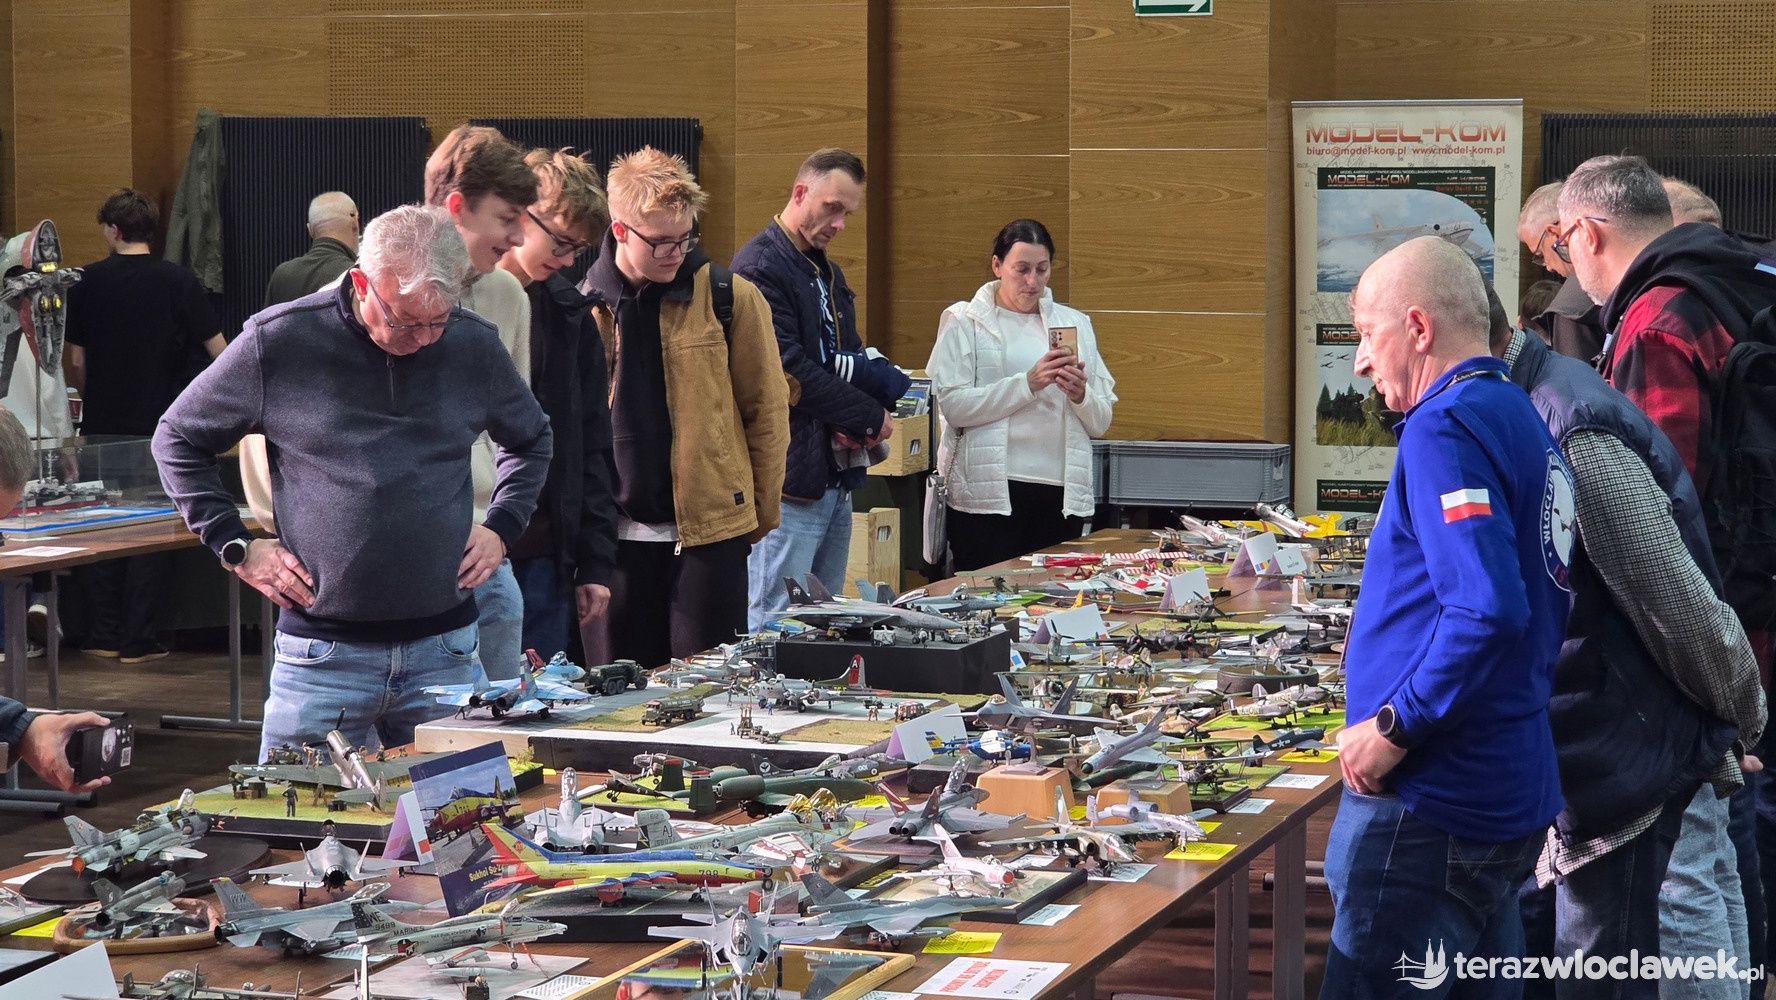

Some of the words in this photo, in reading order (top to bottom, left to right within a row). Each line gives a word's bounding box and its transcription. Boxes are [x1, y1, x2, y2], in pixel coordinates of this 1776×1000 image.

[1306, 121, 1506, 143] MODEL-KOM
[1306, 146, 1407, 157] biuro@model-kom.pl
[1413, 146, 1506, 156] www.model-kom.pl
[1327, 174, 1410, 185] MODEL-KOM
[469, 867, 489, 882] Sukhoi
[393, 925, 425, 937] MARINES
